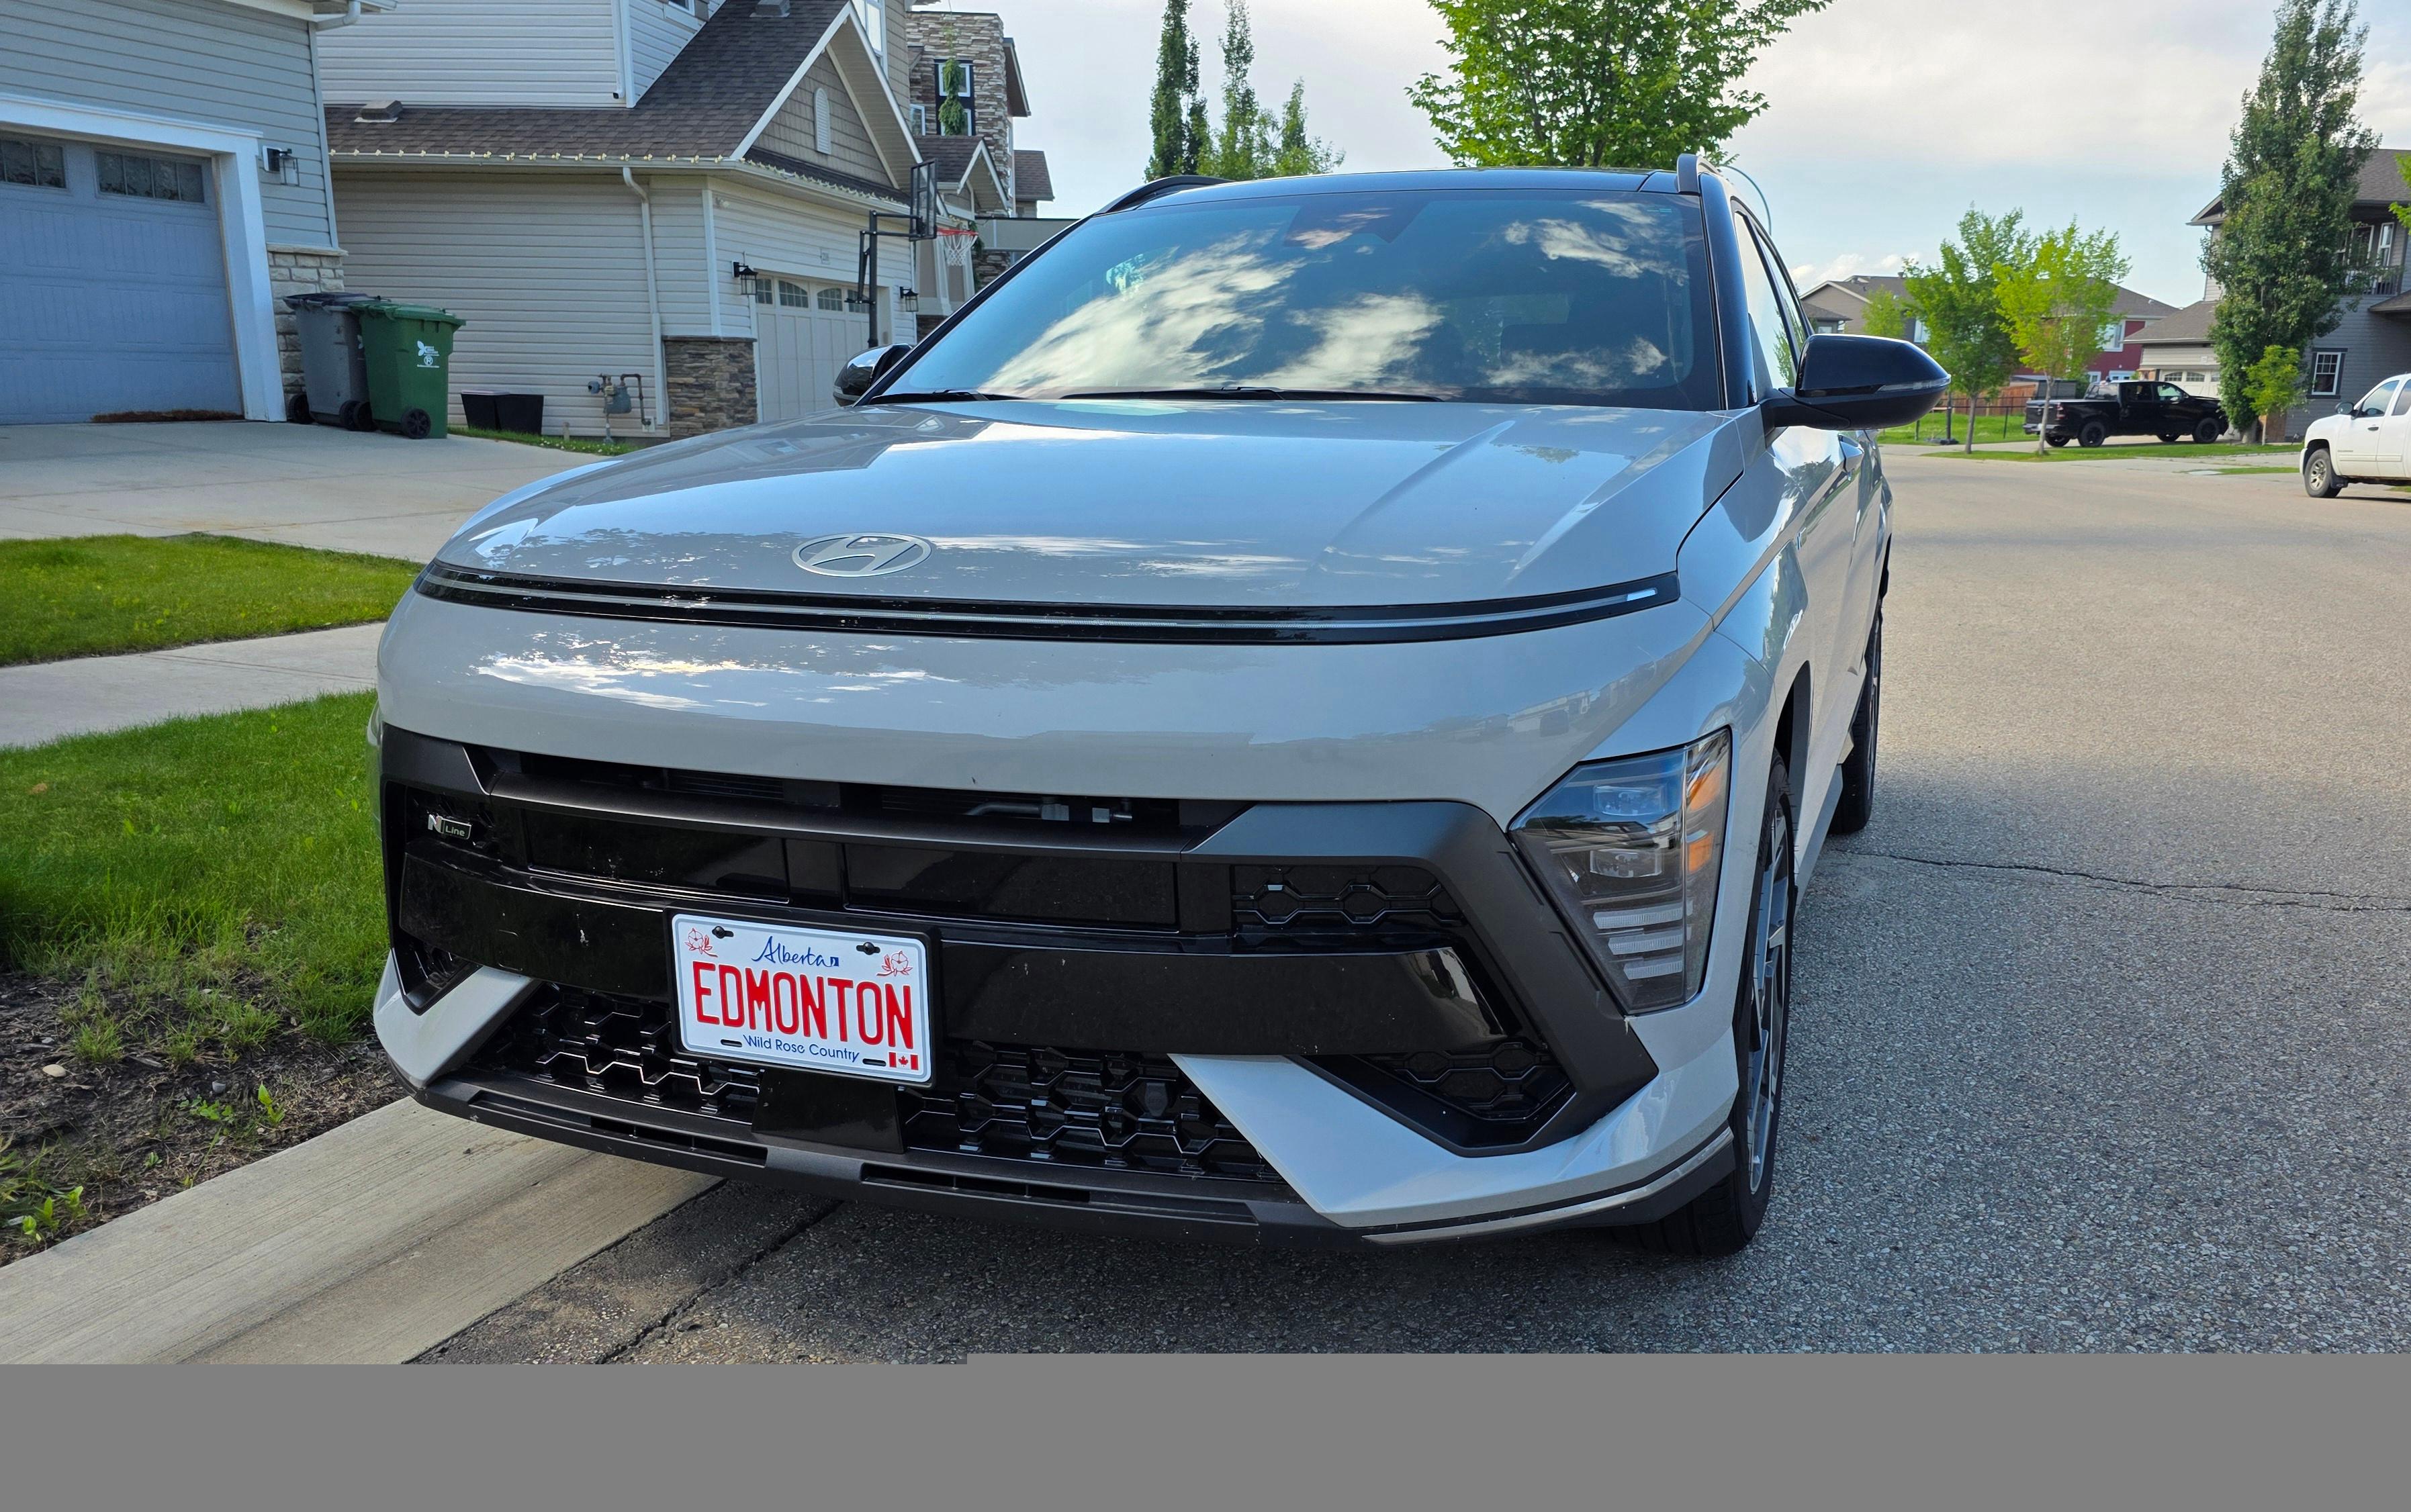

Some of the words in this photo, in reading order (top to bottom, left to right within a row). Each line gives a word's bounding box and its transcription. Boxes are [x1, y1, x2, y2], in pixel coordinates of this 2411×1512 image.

[428, 814, 443, 834] N
[445, 825, 465, 837] Line
[752, 935, 832, 967] Alberta
[692, 961, 914, 1049] EDMONTON
[743, 1035, 772, 1050] Wild
[776, 1038, 805, 1055] Rose
[809, 1044, 860, 1063] Country
